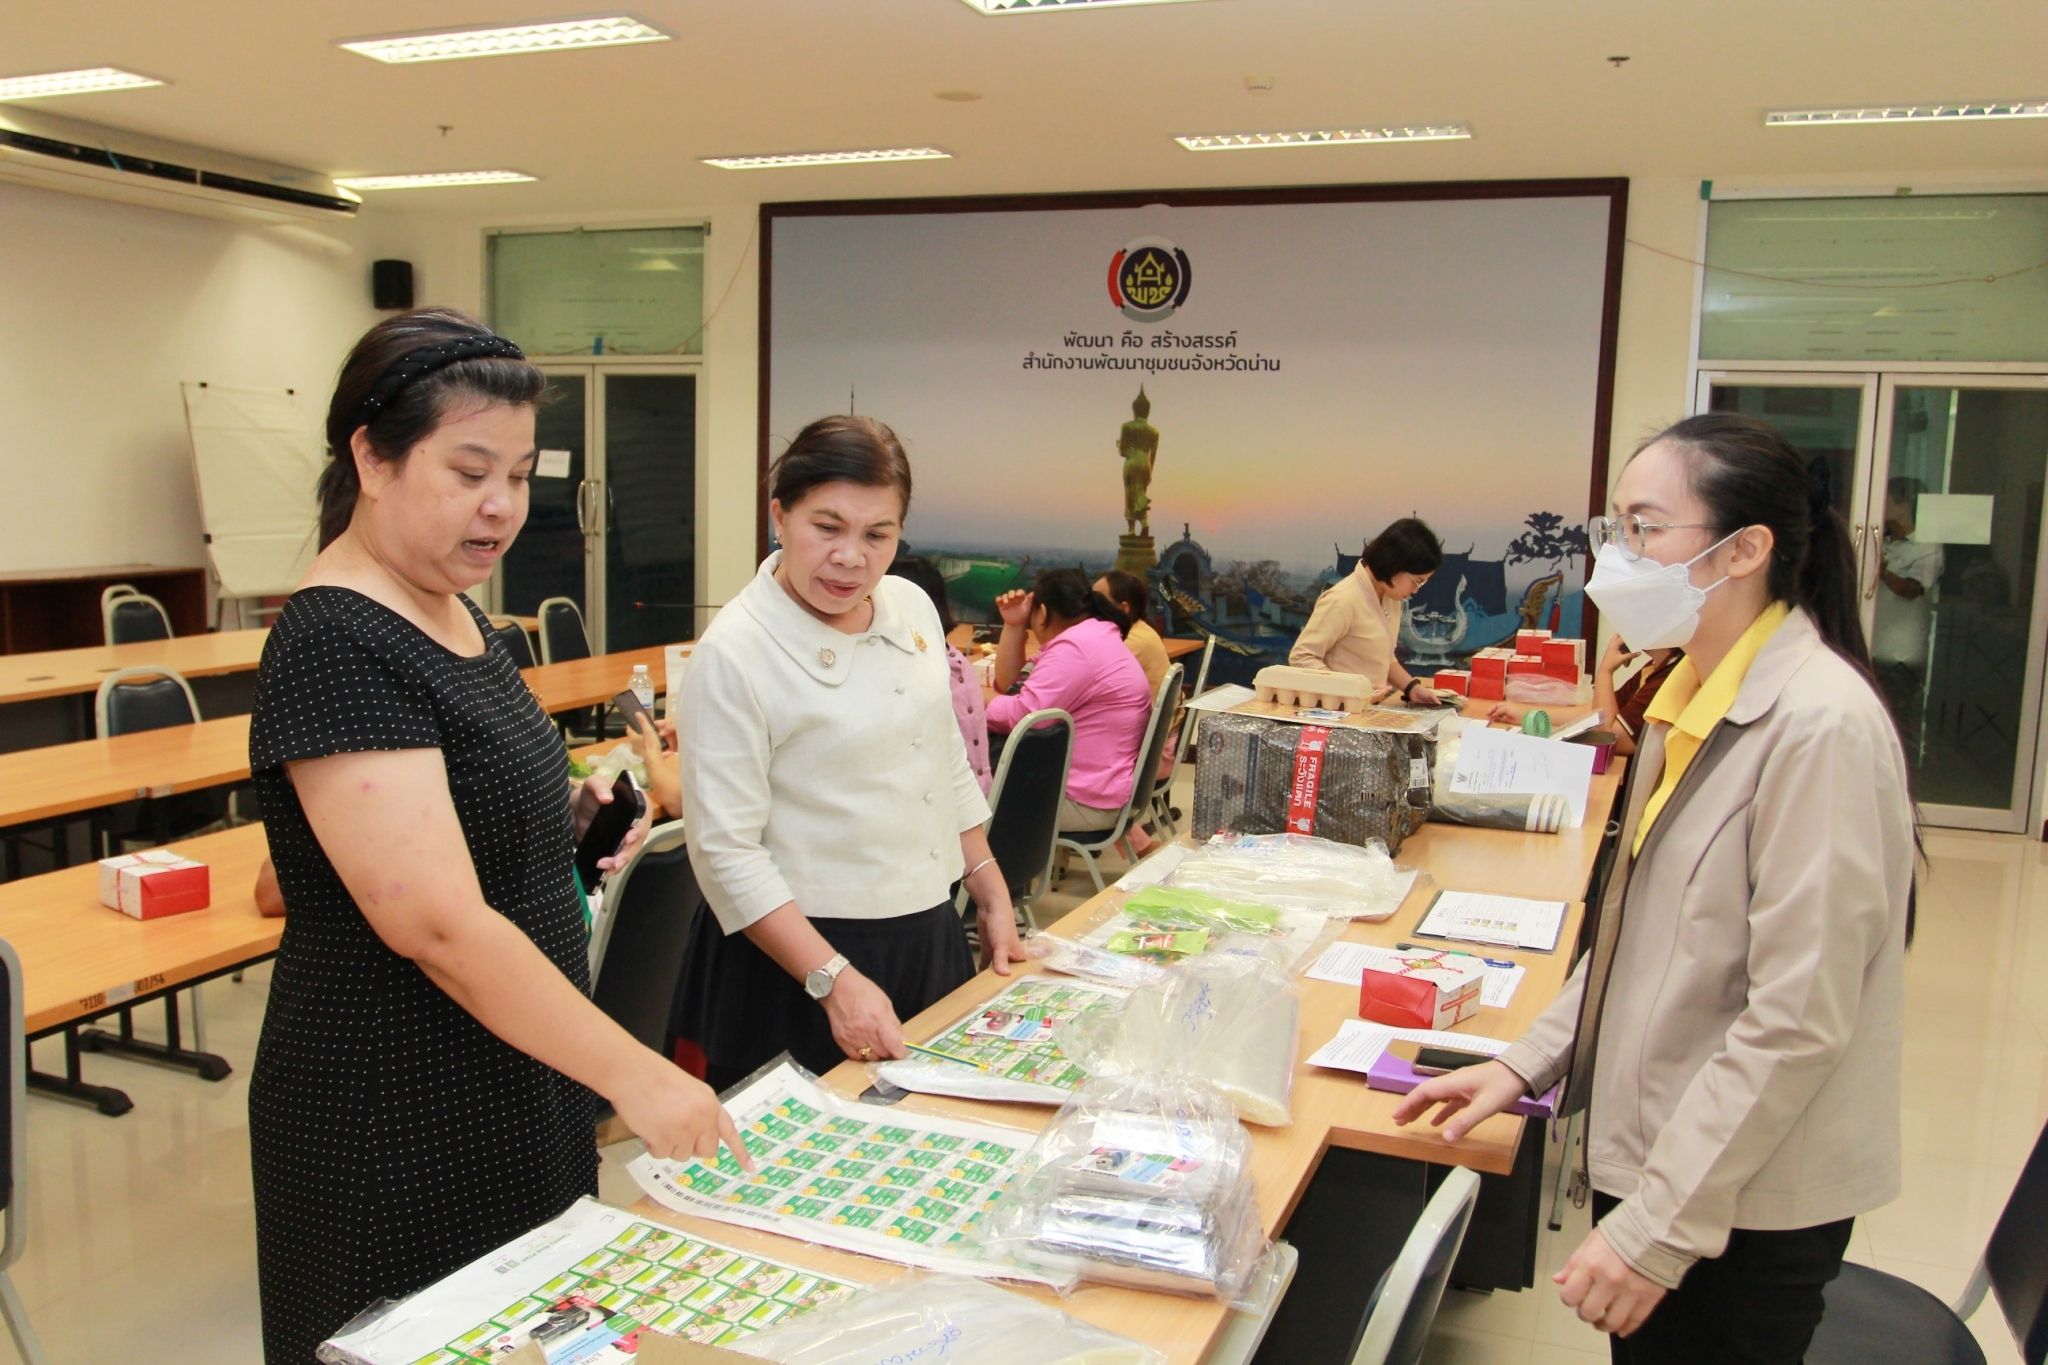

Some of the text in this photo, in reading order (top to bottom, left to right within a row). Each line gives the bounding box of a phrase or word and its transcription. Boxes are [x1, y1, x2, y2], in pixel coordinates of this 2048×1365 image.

[1063, 330, 1237, 348] พัฒนา คือ สร้างสรรค์
[1022, 352, 1280, 375] สำนักงานพัฒนาชุมชนจังหวัดน่าน
[1293, 756, 1307, 807] ระวังแตก
[1304, 757, 1318, 808] FRAGILE
